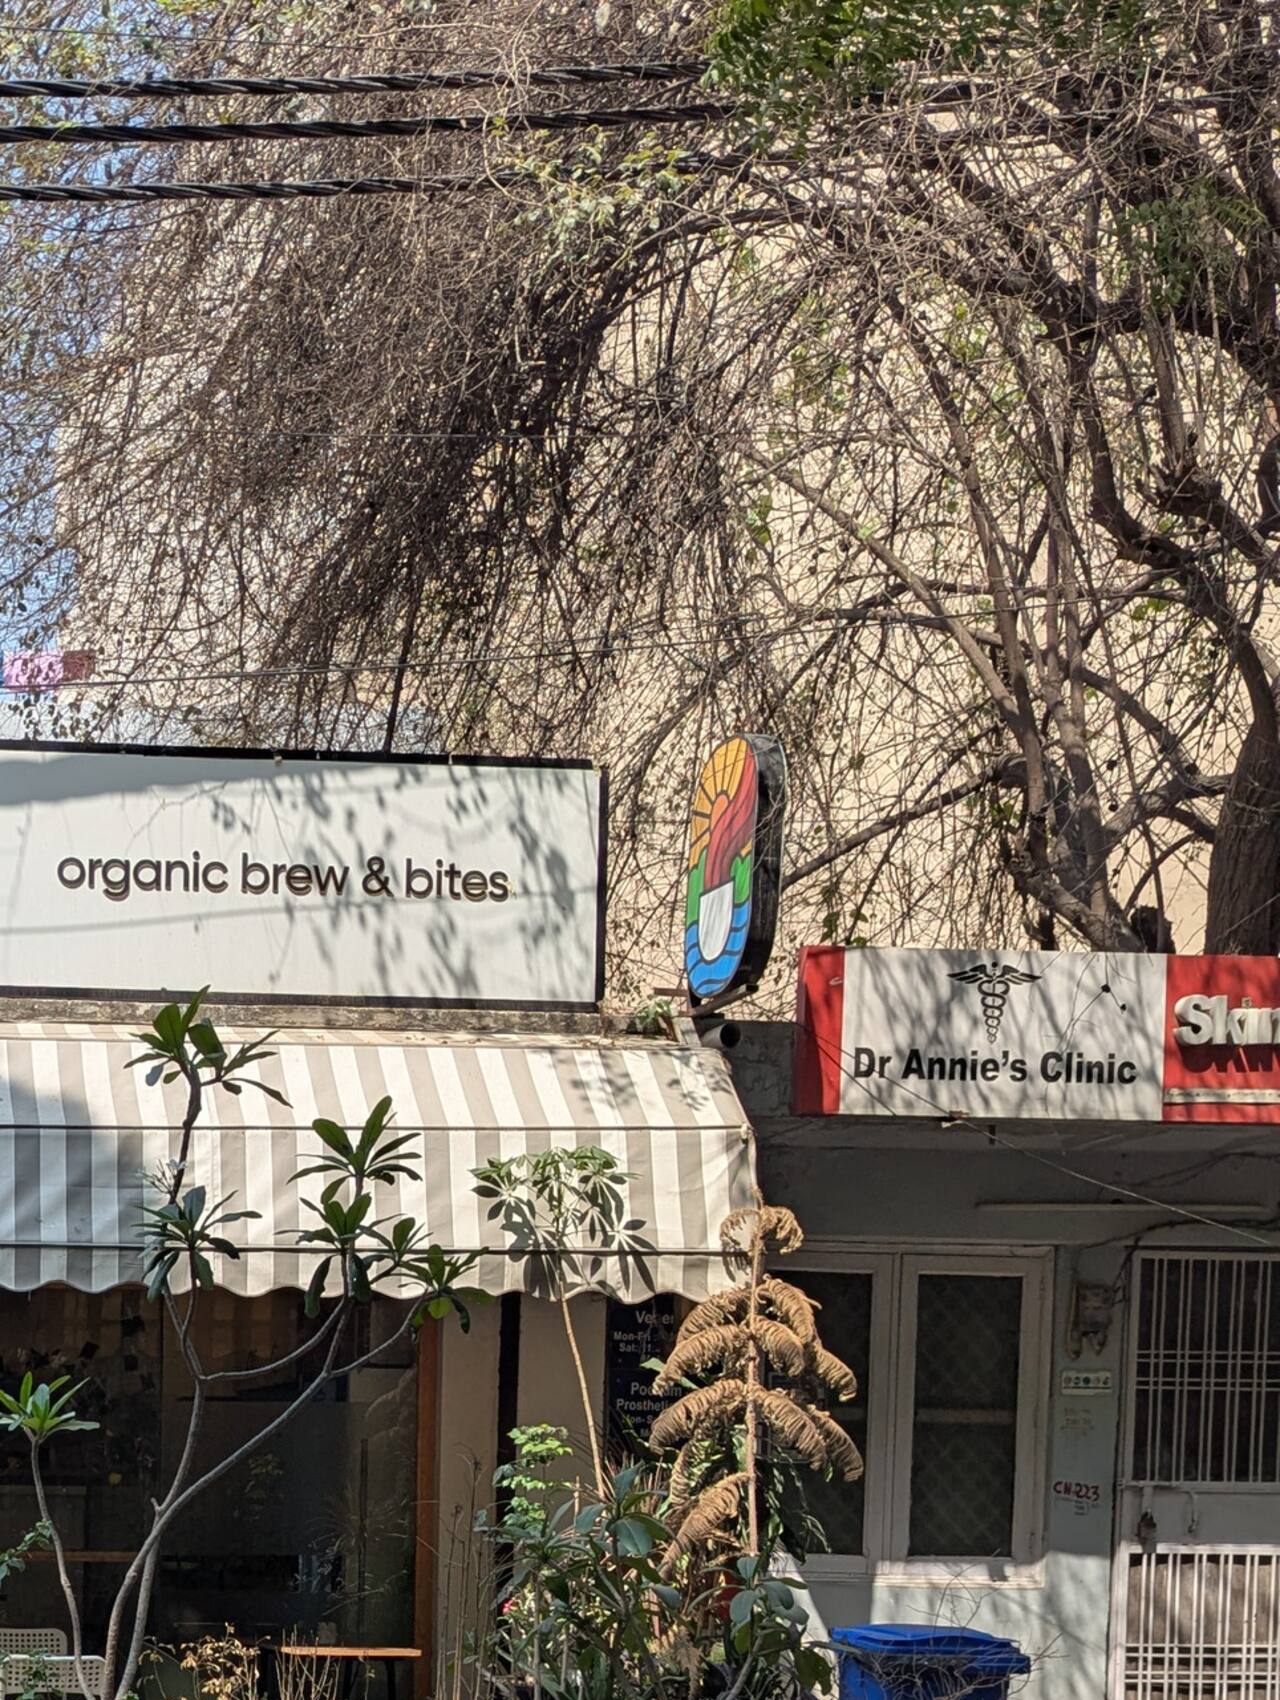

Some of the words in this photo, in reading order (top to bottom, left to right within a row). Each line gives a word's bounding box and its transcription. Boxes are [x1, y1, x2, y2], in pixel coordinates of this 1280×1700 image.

[57, 850, 229, 902] organic
[240, 852, 350, 897] brew
[361, 855, 395, 898] &
[404, 857, 510, 902] bites
[853, 1047, 892, 1079] Dr
[902, 1049, 1028, 1083] Annie's
[1040, 1050, 1138, 1085] Clinic
